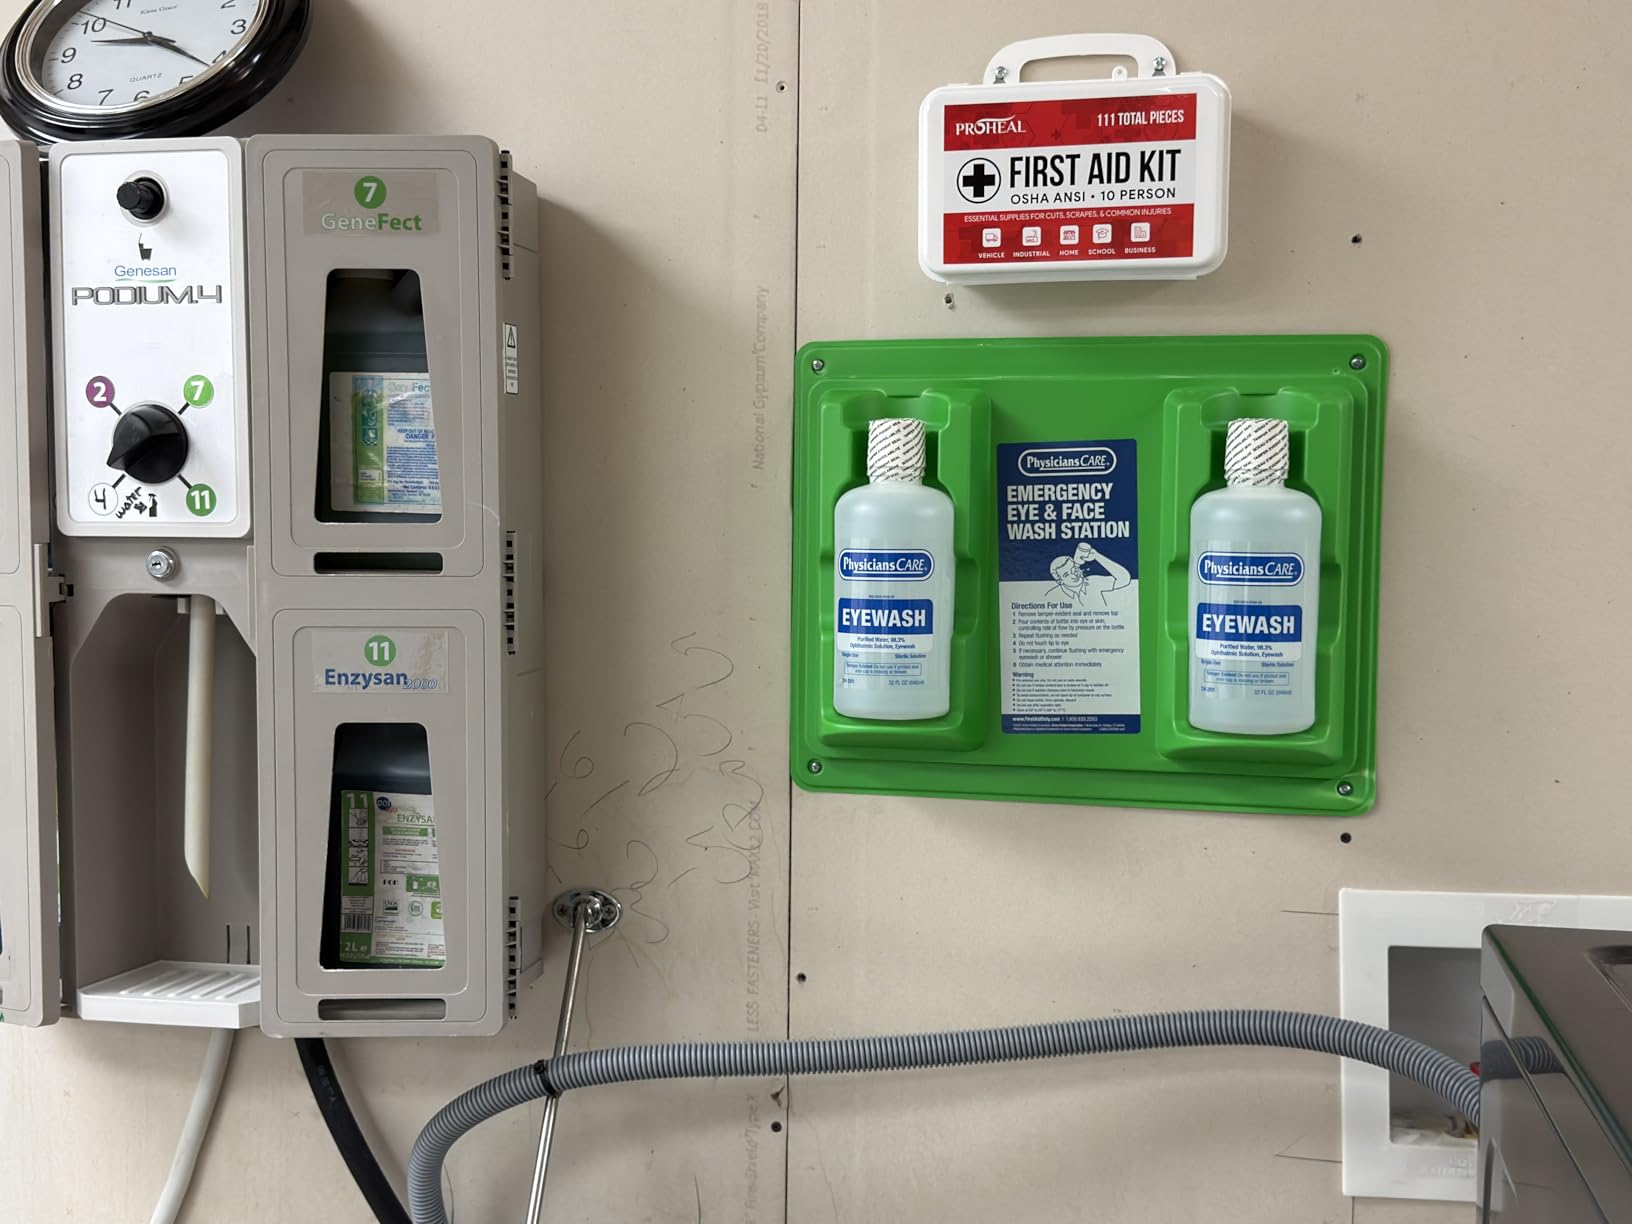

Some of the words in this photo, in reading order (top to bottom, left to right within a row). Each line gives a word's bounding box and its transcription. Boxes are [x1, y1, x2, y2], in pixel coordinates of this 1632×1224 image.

[80, 17, 106, 35] 10
[230, 19, 246, 35] 3
[60, 47, 77, 64] 9
[66, 73, 83, 90] 8
[129, 73, 163, 83] QUARTZ
[98, 89, 114, 106] 7
[956, 114, 1027, 136] PROHEAL
[1097, 113, 1115, 127] 111
[1118, 111, 1148, 126] TOTAL
[1150, 110, 1184, 124] PIECES
[1009, 154, 1081, 188] FIRST
[1088, 152, 1131, 185] AID
[1140, 149, 1182, 182] KIT
[362, 182, 378, 202] 7
[1010, 193, 1049, 205] OSHA
[1054, 191, 1086, 203] ANSI
[1100, 190, 1115, 201] 10
[1120, 188, 1176, 200] PERSON
[321, 212, 422, 231] GeneFect
[964, 214, 998, 222] ESSENTIAL
[1000, 213, 1030, 222] SUPPLIES
[1105, 208, 1140, 216] COMMON
[1141, 208, 1172, 216] INJURIES
[114, 265, 177, 276] Genesan
[72, 284, 222, 306] PODIUM.4
[93, 381, 107, 402] 2
[190, 380, 205, 401] 7
[753, 354, 769, 410] Gypsum
[751, 412, 766, 471] National
[94, 487, 107, 510] 4
[190, 490, 212, 510] 11
[1006, 482, 1114, 502] EMERGENCY
[1007, 504, 1040, 521] EYE
[1044, 504, 1057, 520] &
[1062, 502, 1105, 520] FACE
[1006, 522, 1056, 540] WASH
[1061, 521, 1130, 539] STATION
[842, 608, 926, 628] EYEWASH
[1202, 613, 1295, 635] EYEWASH
[368, 641, 390, 661] 11
[324, 668, 409, 690] Enzysan
[745, 921, 760, 996] FASTENERS
[745, 1000, 760, 1033] LESS
